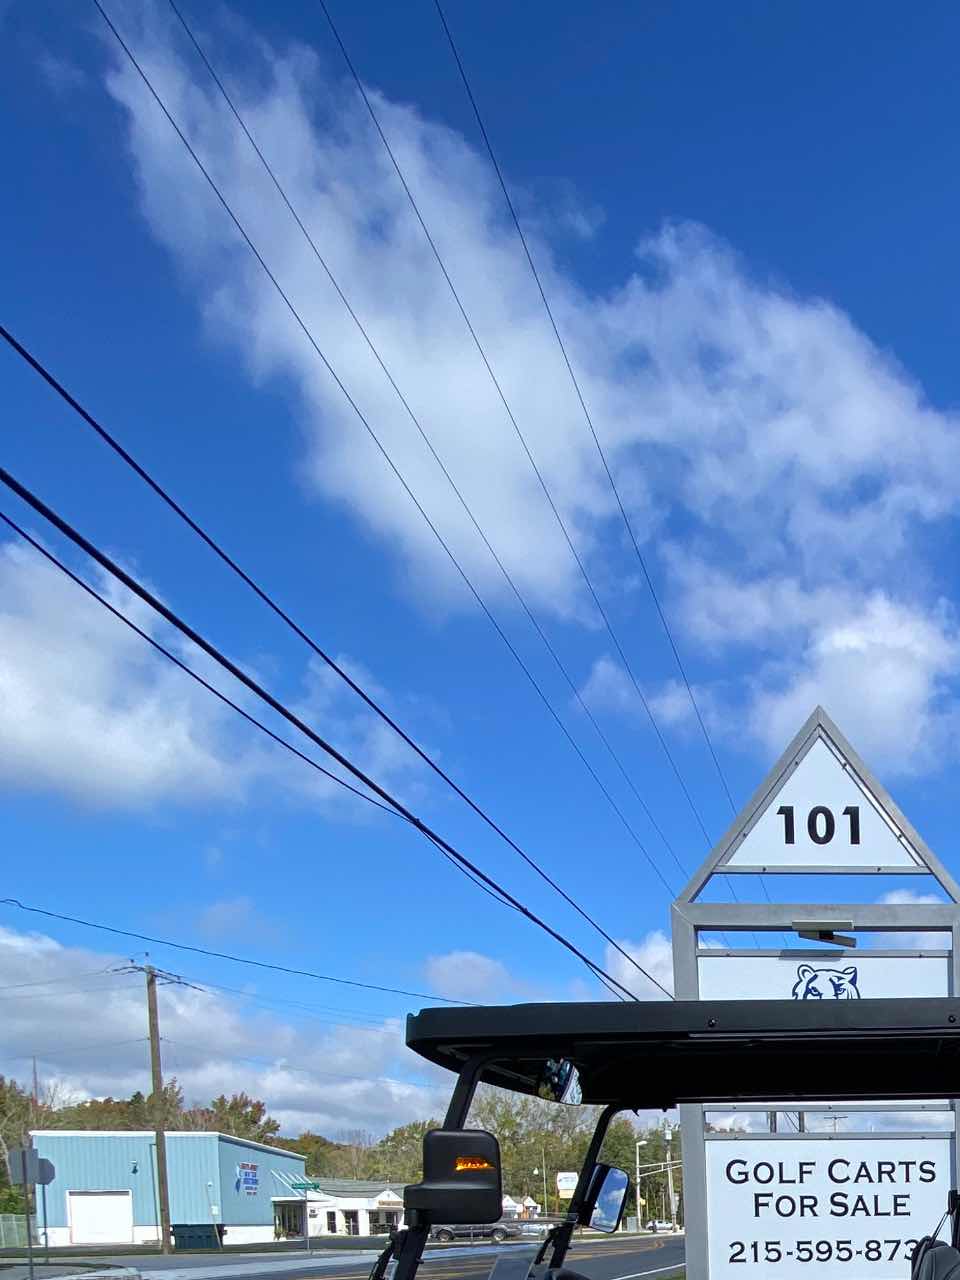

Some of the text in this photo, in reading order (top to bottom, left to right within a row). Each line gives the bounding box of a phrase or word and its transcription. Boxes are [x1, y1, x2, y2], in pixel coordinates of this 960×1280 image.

[776, 805, 861, 845] 101
[725, 1158, 936, 1184] GOLF CARTS
[753, 1191, 911, 1218] FOR SALE
[728, 1239, 919, 1264] 215-595-873
